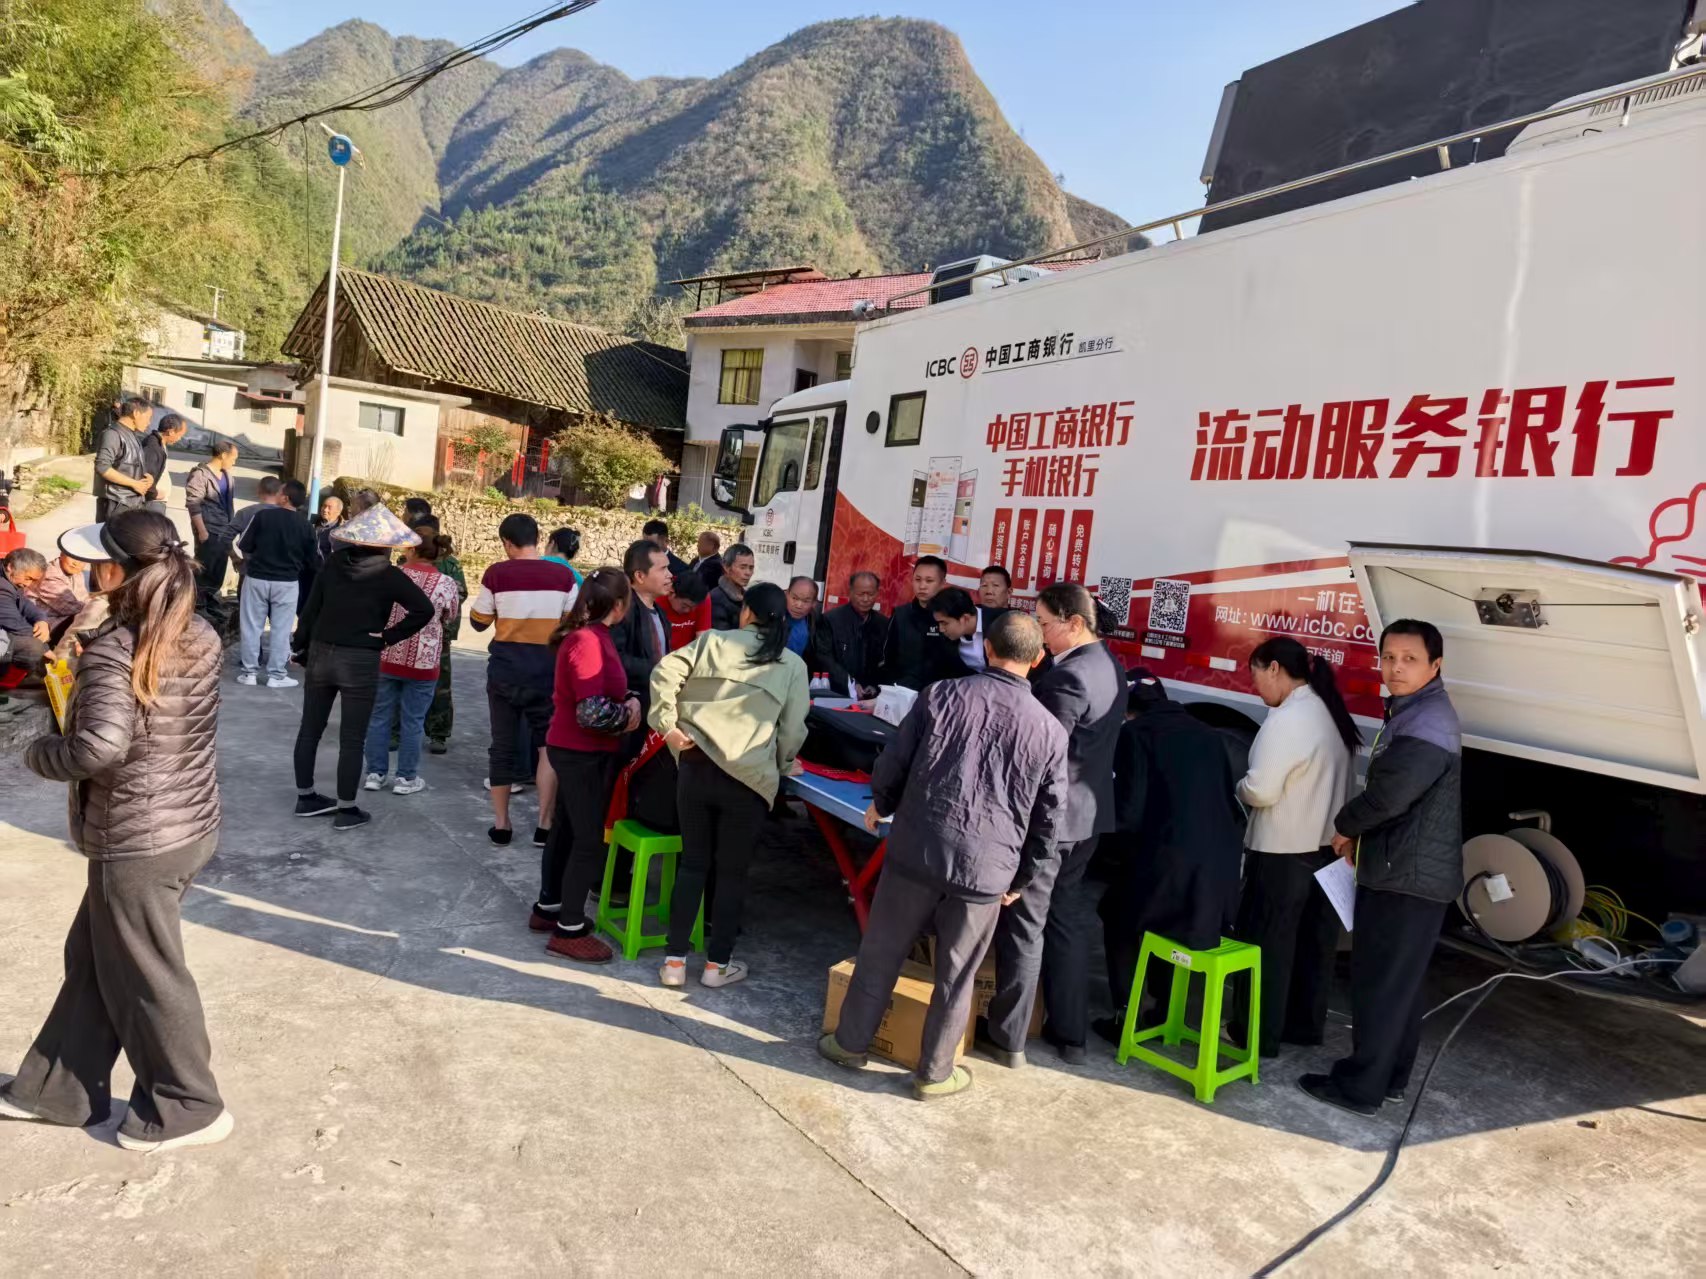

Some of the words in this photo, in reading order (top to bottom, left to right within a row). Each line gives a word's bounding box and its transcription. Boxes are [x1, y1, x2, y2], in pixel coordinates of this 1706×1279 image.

[925, 356, 957, 379] ICBC
[985, 332, 1074, 368] 中国工商银行
[1077, 336, 1114, 353] 凯里分行
[986, 400, 1135, 452] 中国工商银行
[1190, 376, 1675, 481] 流动服务银行
[1001, 454, 1100, 497] 手机银行
[1070, 524, 1085, 581] 免费转账
